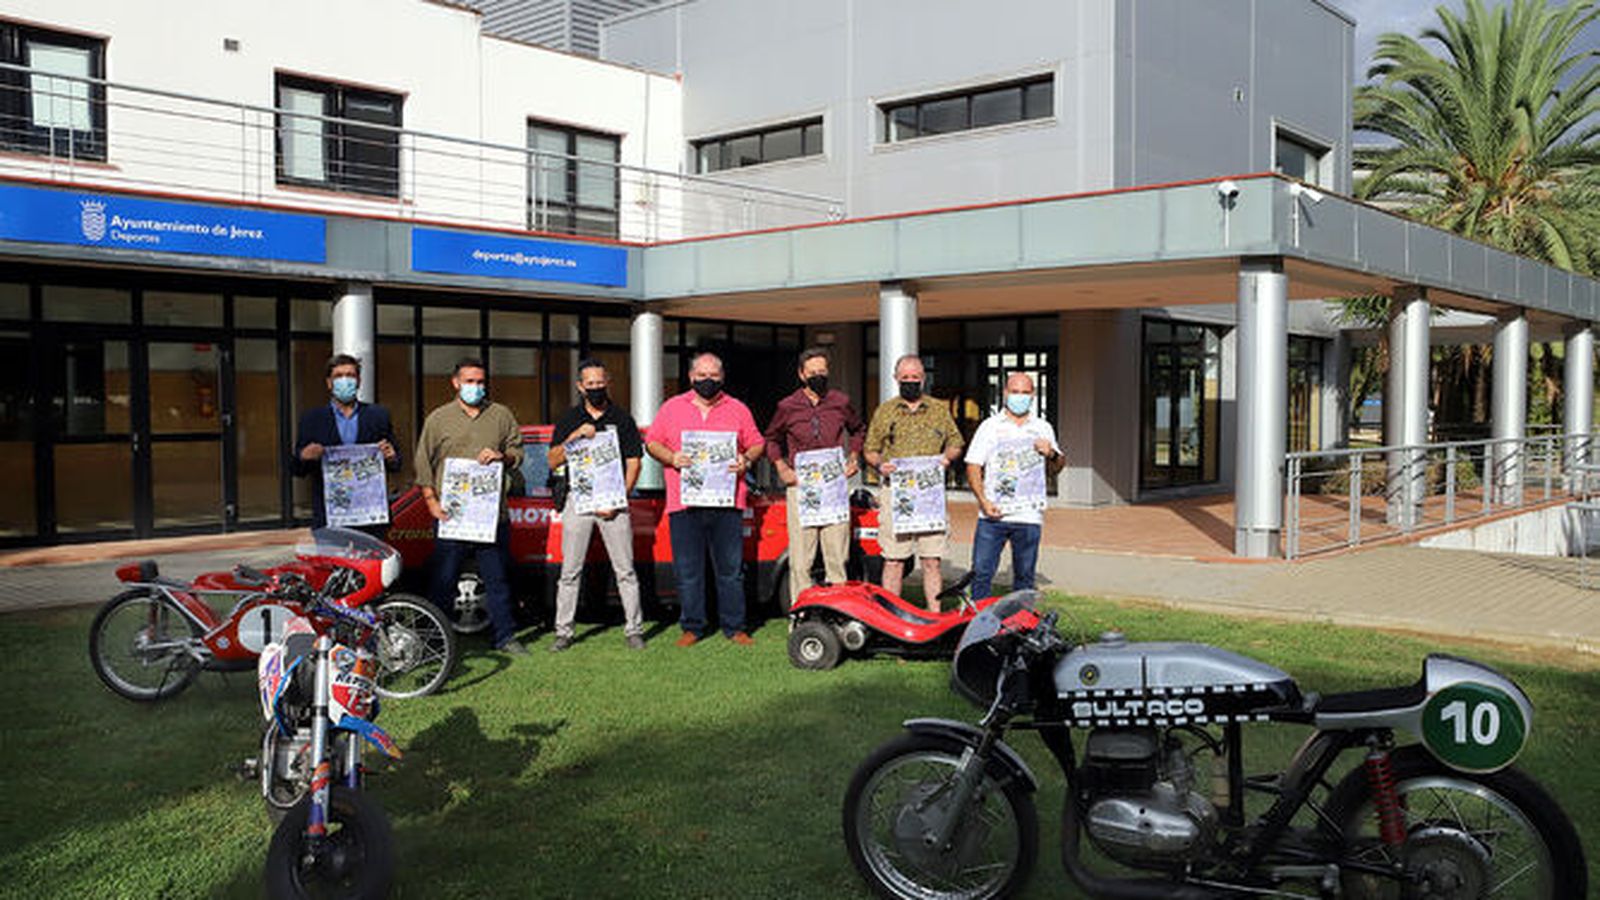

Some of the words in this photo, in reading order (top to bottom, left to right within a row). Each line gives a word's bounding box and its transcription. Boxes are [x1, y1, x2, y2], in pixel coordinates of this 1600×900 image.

[110, 214, 209, 236] Ayuntamiento
[211, 224, 228, 237] de
[230, 225, 264, 239] Jerez
[110, 229, 161, 244] Deportes
[261, 608, 272, 646] 1
[1072, 699, 1204, 718] BULTACO
[1441, 700, 1500, 745] 10
